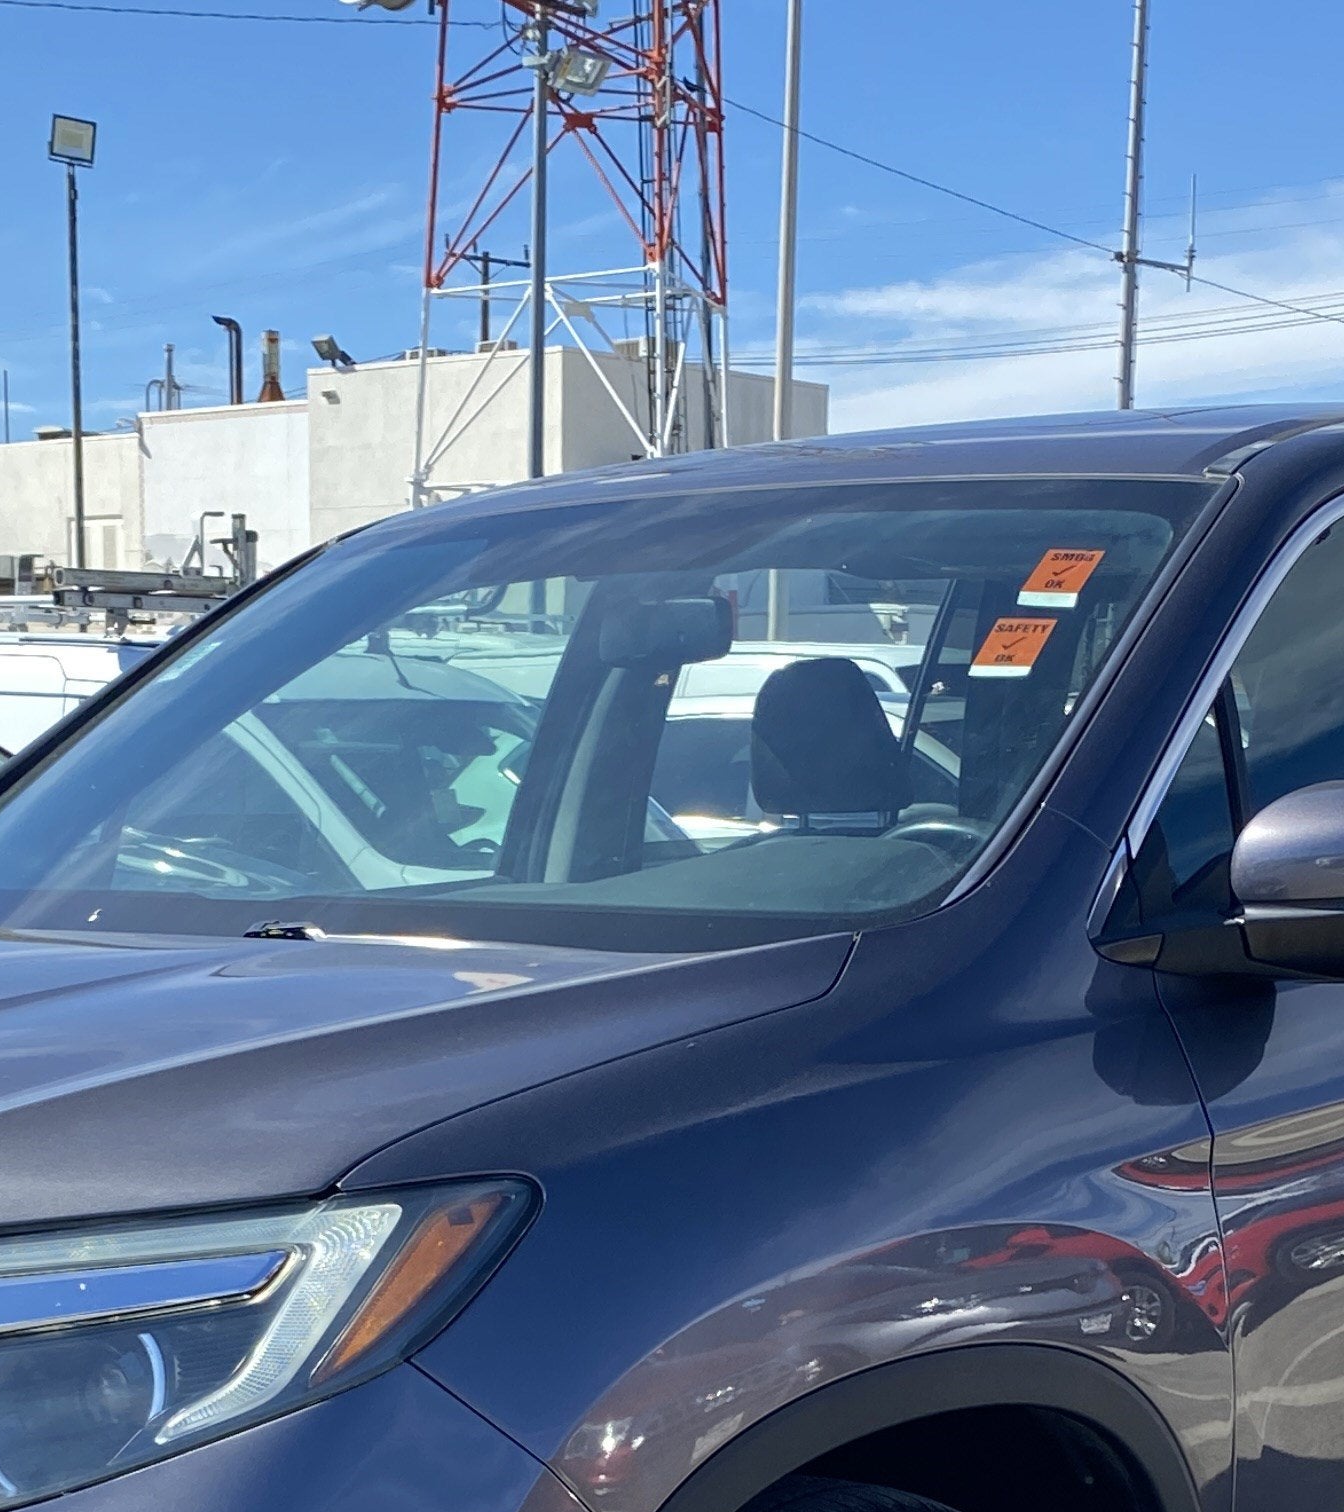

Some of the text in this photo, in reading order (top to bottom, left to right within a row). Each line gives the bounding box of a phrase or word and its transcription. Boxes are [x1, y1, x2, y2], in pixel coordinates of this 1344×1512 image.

[1050, 552, 1095, 562] SMOG
[1044, 579, 1065, 589] OK
[994, 623, 1050, 634] SAFETY
[994, 654, 1016, 663] OK
